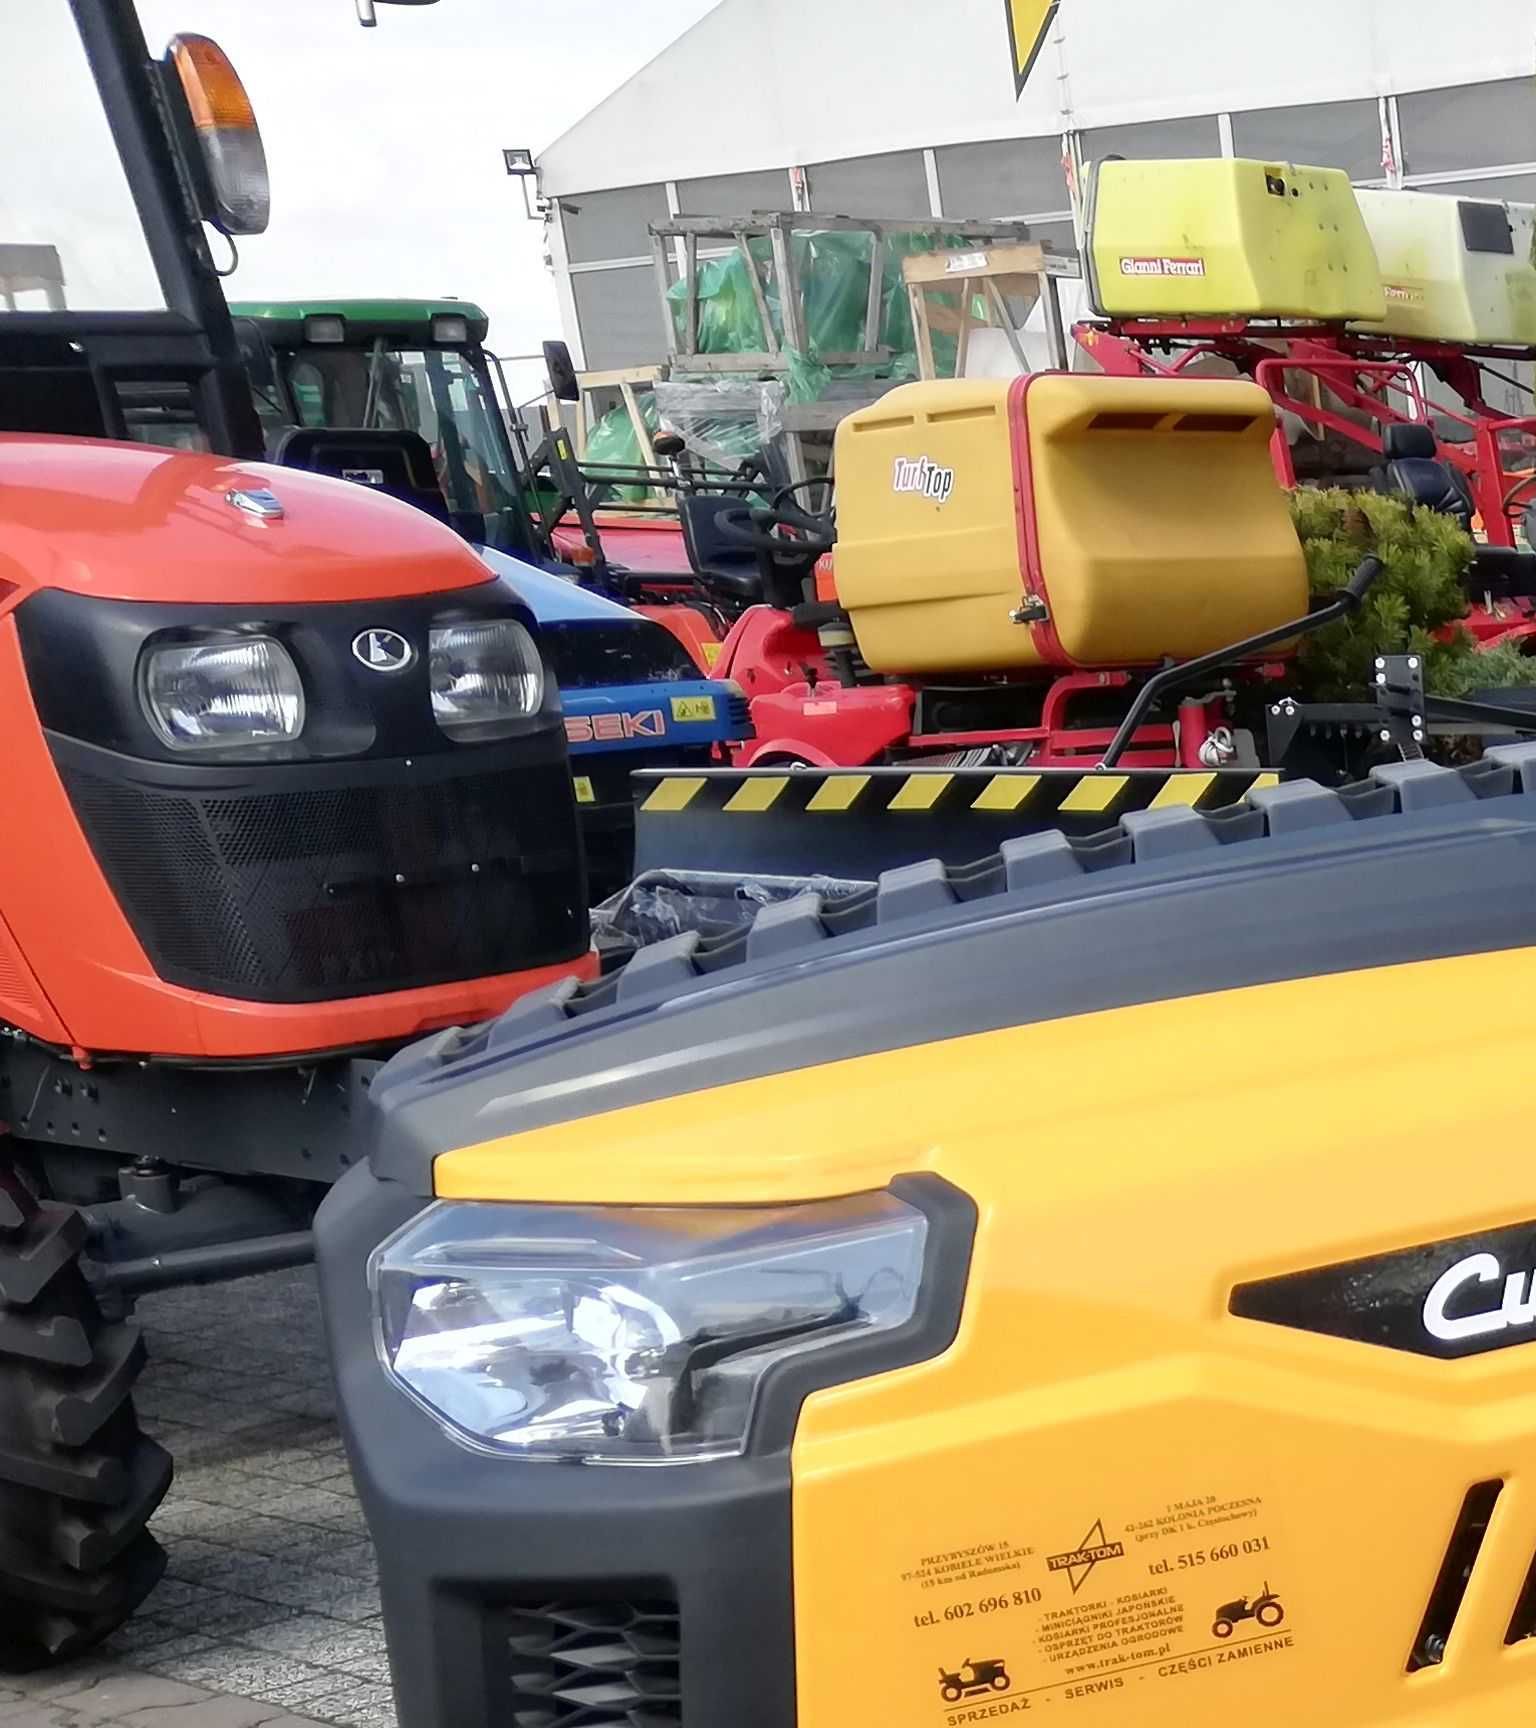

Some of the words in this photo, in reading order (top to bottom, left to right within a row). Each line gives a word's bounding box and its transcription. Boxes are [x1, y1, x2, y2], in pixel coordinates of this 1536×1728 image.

[1121, 257, 1162, 275] Gianni
[1161, 258, 1204, 276] Ferrari
[1147, 1562, 1174, 1576] tel.
[1177, 1551, 1206, 1570] 515
[1210, 1543, 1239, 1562] 660
[1242, 1535, 1271, 1555] 031
[913, 1610, 941, 1628] tel.
[944, 1602, 975, 1621] 602
[978, 1594, 1009, 1614] 696
[1012, 1587, 1042, 1606] 810
[1116, 1586, 1168, 1604] KOSIARKI
[1038, 1624, 1091, 1643] KOSIARKI
[1120, 1625, 1185, 1646] OGRODOWE
[1064, 1642, 1171, 1675] www.trak-tom.pl
[946, 1697, 1032, 1727] SPRZEDAŻ
[1065, 1676, 1125, 1700] SERWIS
[1157, 1655, 1213, 1678] CZĘŚCI
[1216, 1635, 1295, 1664] ZAMIENNE
